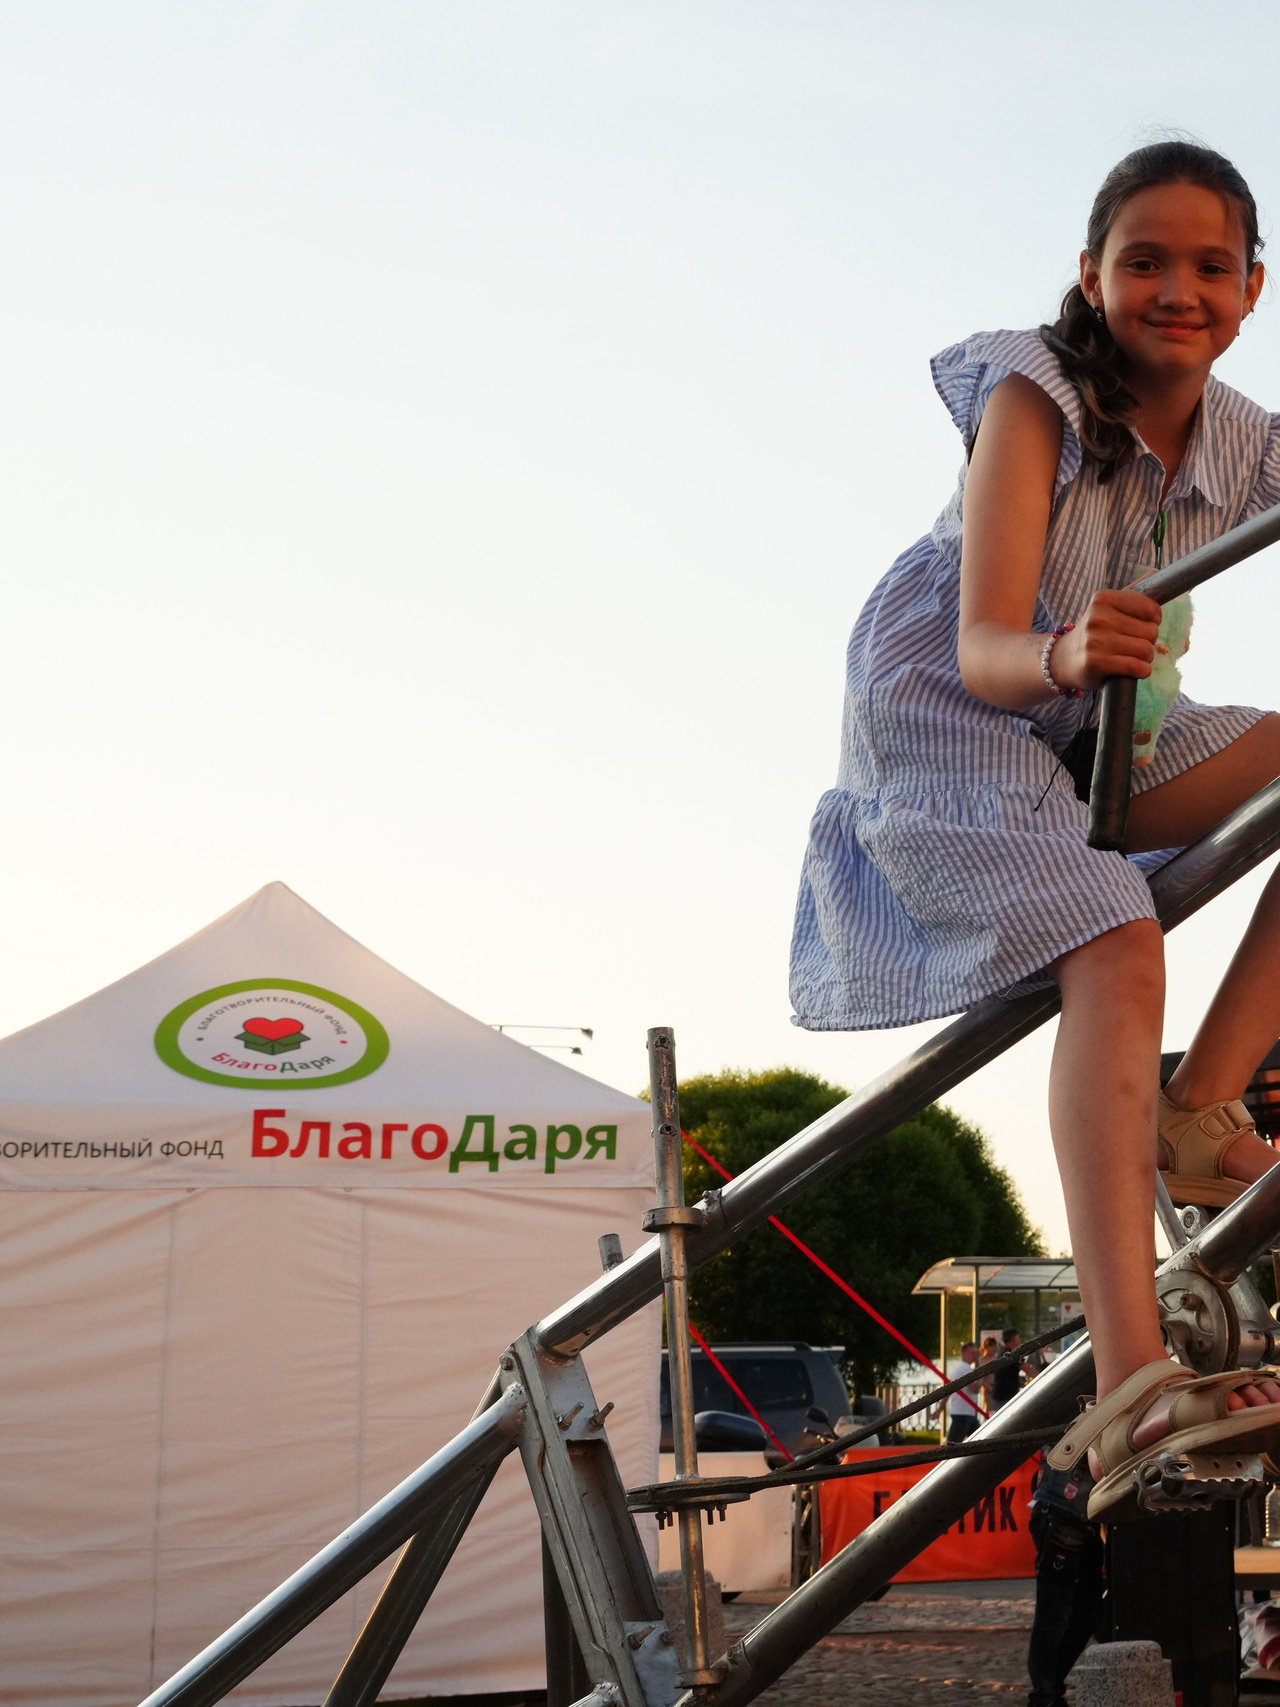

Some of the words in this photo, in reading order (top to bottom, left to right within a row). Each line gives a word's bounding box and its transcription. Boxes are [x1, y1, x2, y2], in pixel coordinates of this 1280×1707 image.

[198, 996, 325, 1031] БЛАГОТВОРИТЕЛЬНЫЙ
[324, 1014, 347, 1035] ФОНД
[211, 1052, 335, 1073] БлагоДаря
[0, 1138, 152, 1158] ОРИТЕЛЬНЫЙ
[160, 1140, 224, 1159] ФОНД
[250, 1109, 619, 1174] БлагоДаря
